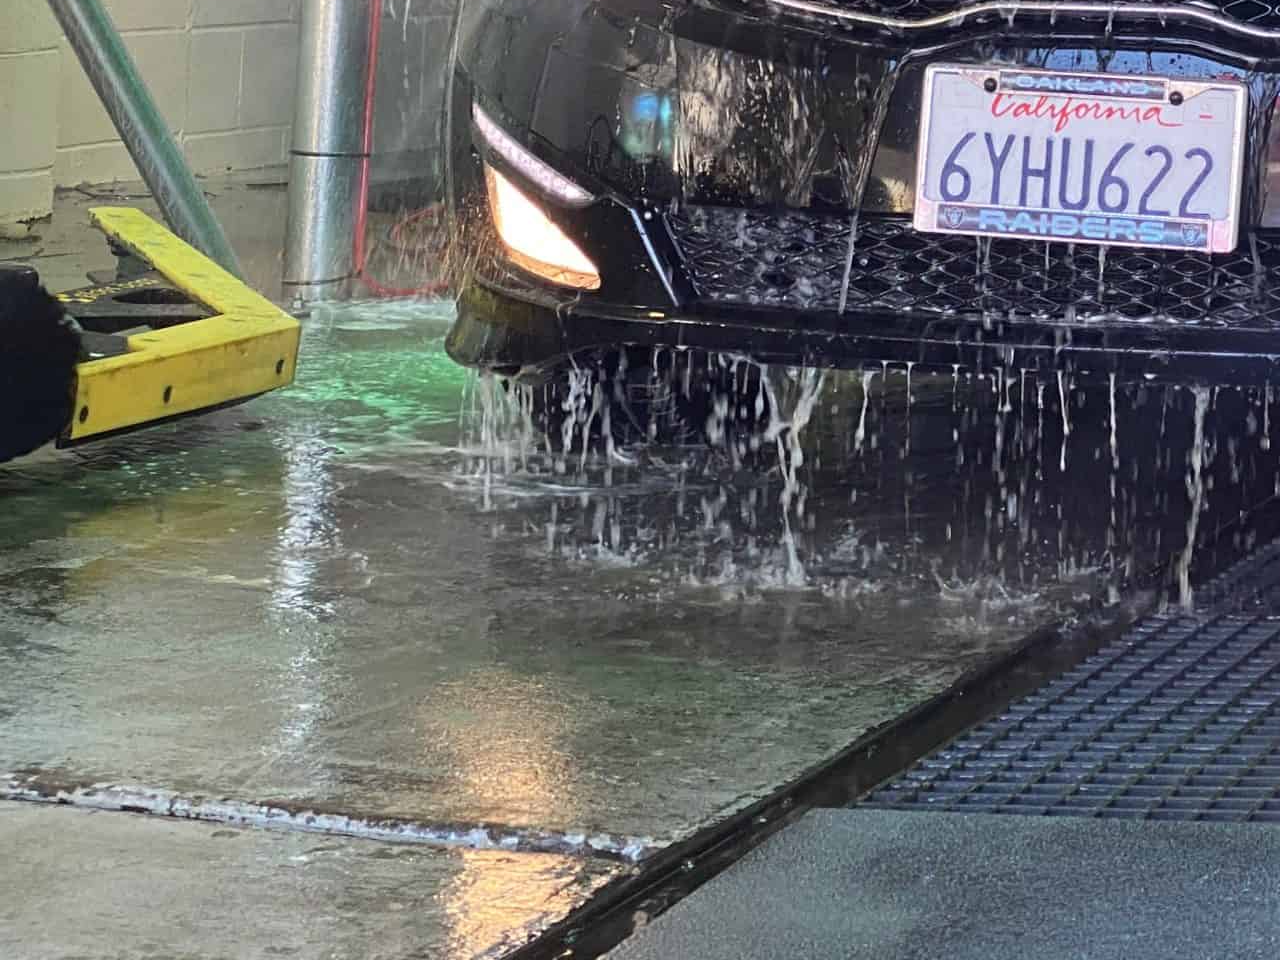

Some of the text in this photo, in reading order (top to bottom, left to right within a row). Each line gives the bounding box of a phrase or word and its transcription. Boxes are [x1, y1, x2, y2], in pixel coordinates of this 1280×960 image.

[1015, 76, 1149, 95] OAKLAND
[991, 92, 1184, 132] California
[940, 132, 1213, 218] 6YHU622
[979, 209, 1165, 242] RAIDERS
